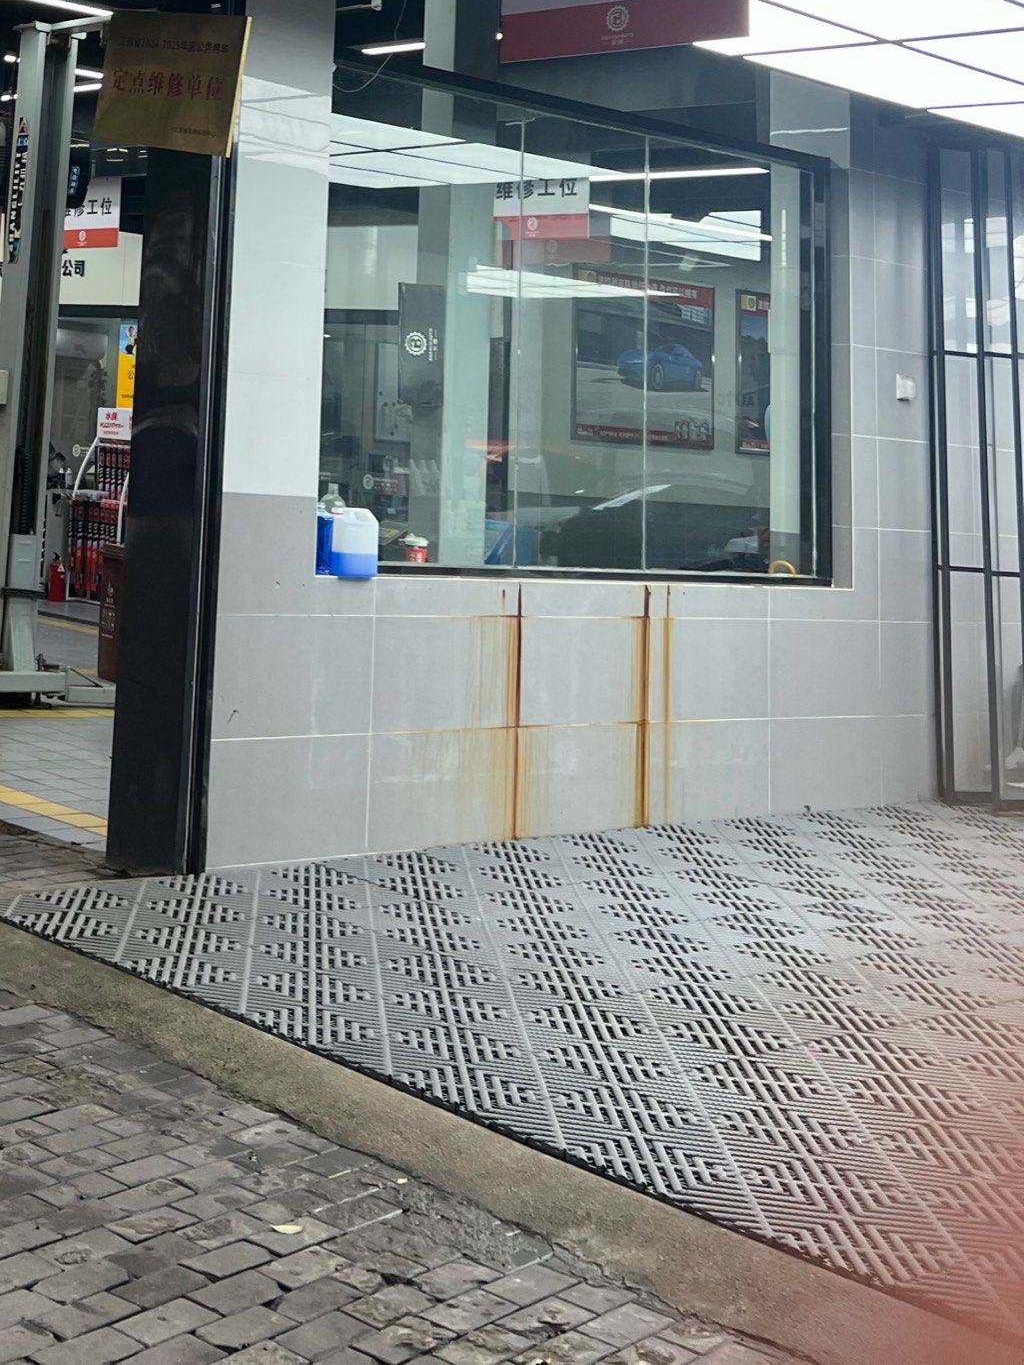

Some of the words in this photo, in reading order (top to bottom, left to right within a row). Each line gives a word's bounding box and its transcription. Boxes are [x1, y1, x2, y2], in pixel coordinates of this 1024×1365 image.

[112, 67, 224, 101] 定点维修单位
[496, 178, 578, 201] 维修工位
